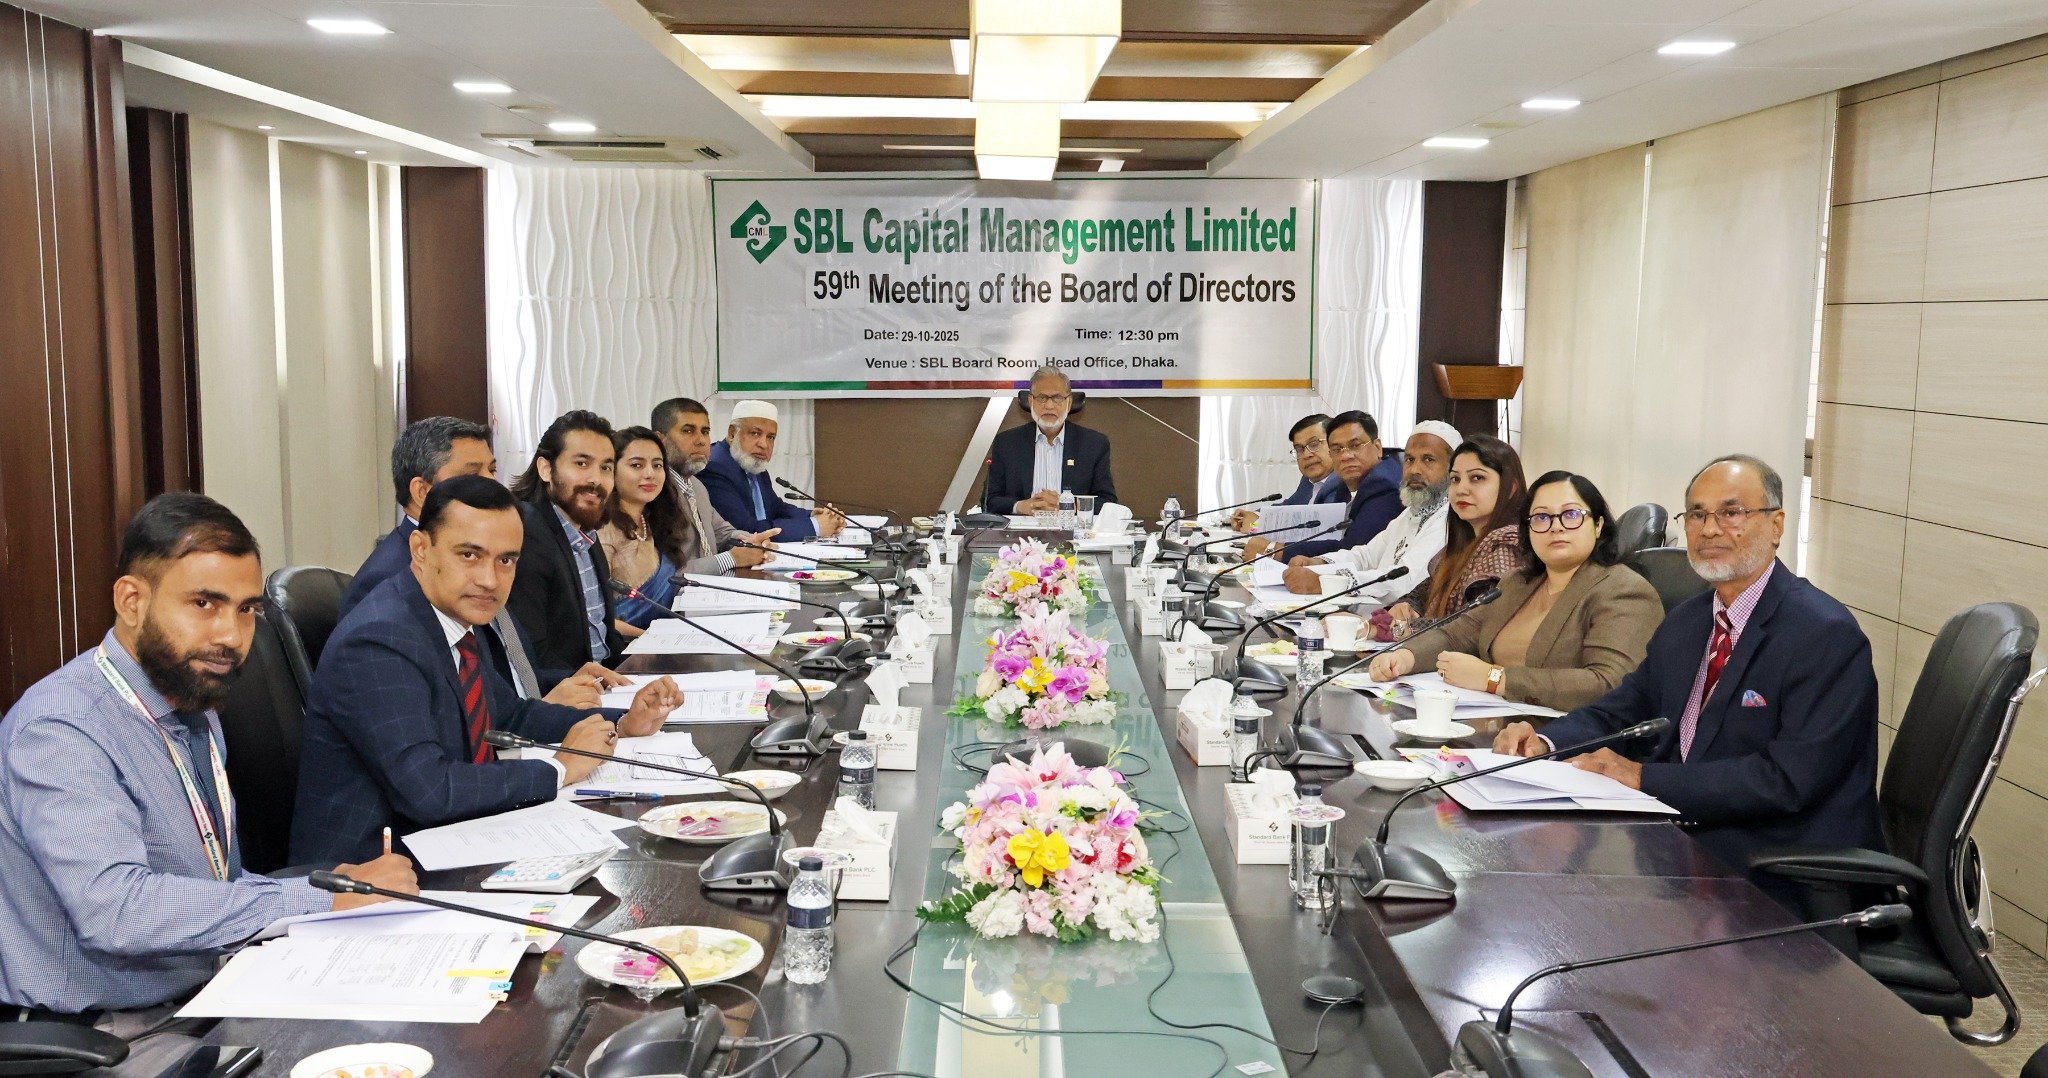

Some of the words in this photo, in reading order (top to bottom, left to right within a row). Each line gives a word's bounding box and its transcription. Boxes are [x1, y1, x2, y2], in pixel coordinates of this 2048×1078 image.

[793, 207, 854, 255] SBL
[862, 207, 969, 265] Capital
[979, 206, 1175, 265] Management
[1185, 206, 1297, 253] Limited
[813, 270, 860, 300] 59th
[868, 273, 971, 312] Meeting
[978, 272, 1006, 304] of
[1010, 273, 1052, 304] the
[1060, 272, 1138, 303] Board
[1146, 272, 1173, 303] of
[1179, 272, 1297, 303] Directors
[864, 329, 899, 340] Date:
[901, 330, 960, 342] 29-10-2025
[1075, 328, 1112, 340] Time:
[1118, 330, 1154, 341] 12:30
[1157, 332, 1179, 343] pm
[865, 357, 908, 369] Venue
[919, 357, 949, 368] SBL
[952, 357, 993, 368] Board
[997, 357, 1042, 370] Room,
[1045, 356, 1080, 368] Head
[1083, 356, 1128, 369] Office,
[1132, 356, 1178, 368] Dhaka.
